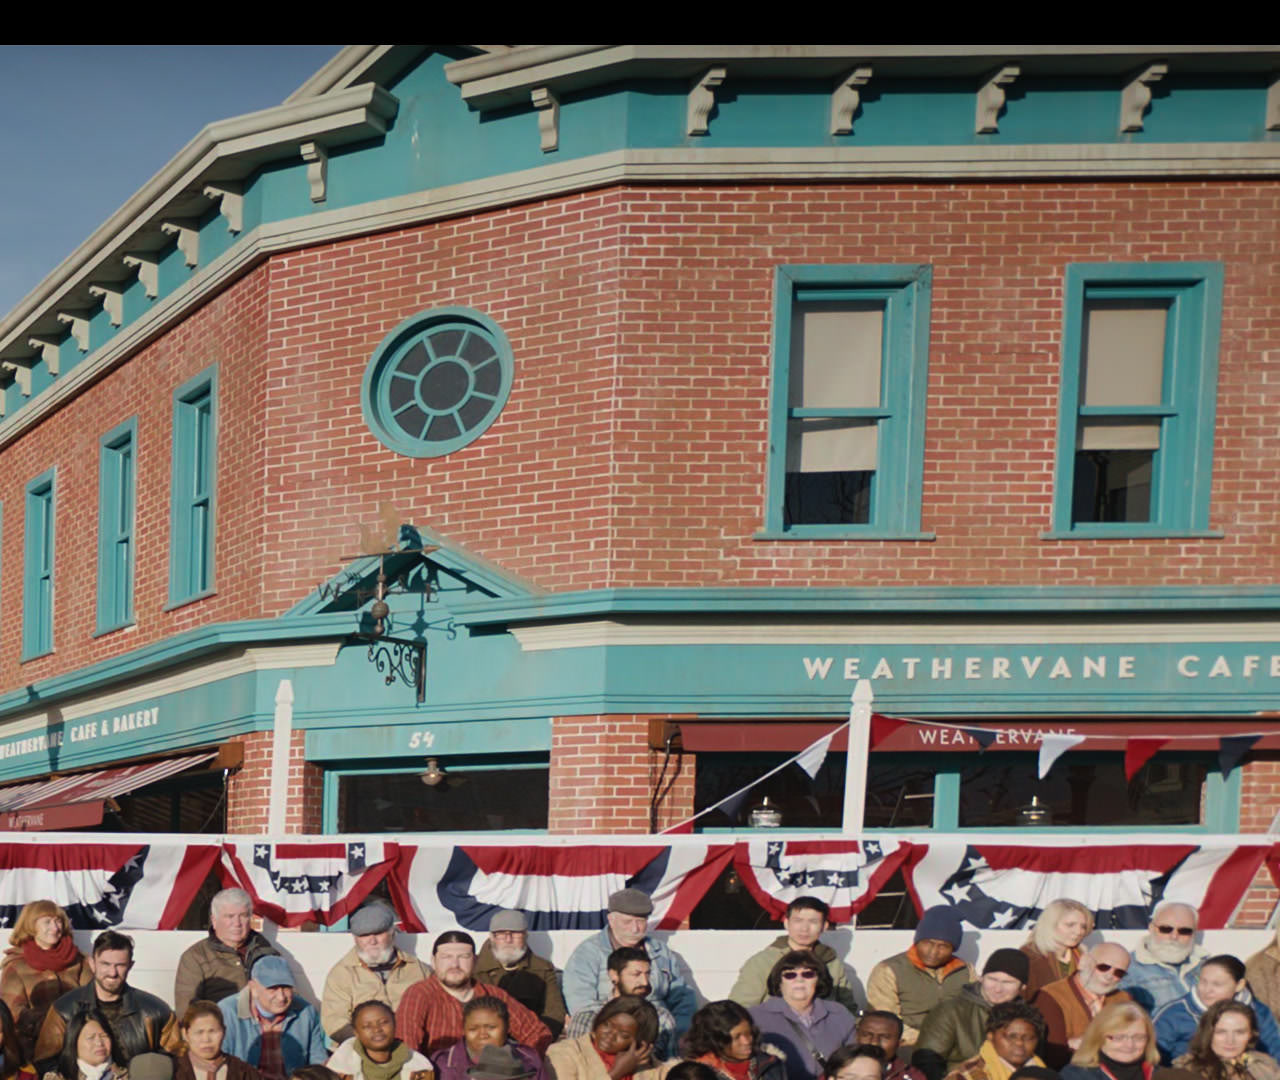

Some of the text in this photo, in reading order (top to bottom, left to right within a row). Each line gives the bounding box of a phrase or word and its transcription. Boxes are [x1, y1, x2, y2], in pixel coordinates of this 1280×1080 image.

[802, 656, 1137, 680] WEATHERVANE
[70, 722, 97, 742] CAFE
[113, 707, 159, 734] BAKERY
[408, 731, 435, 749] 54
